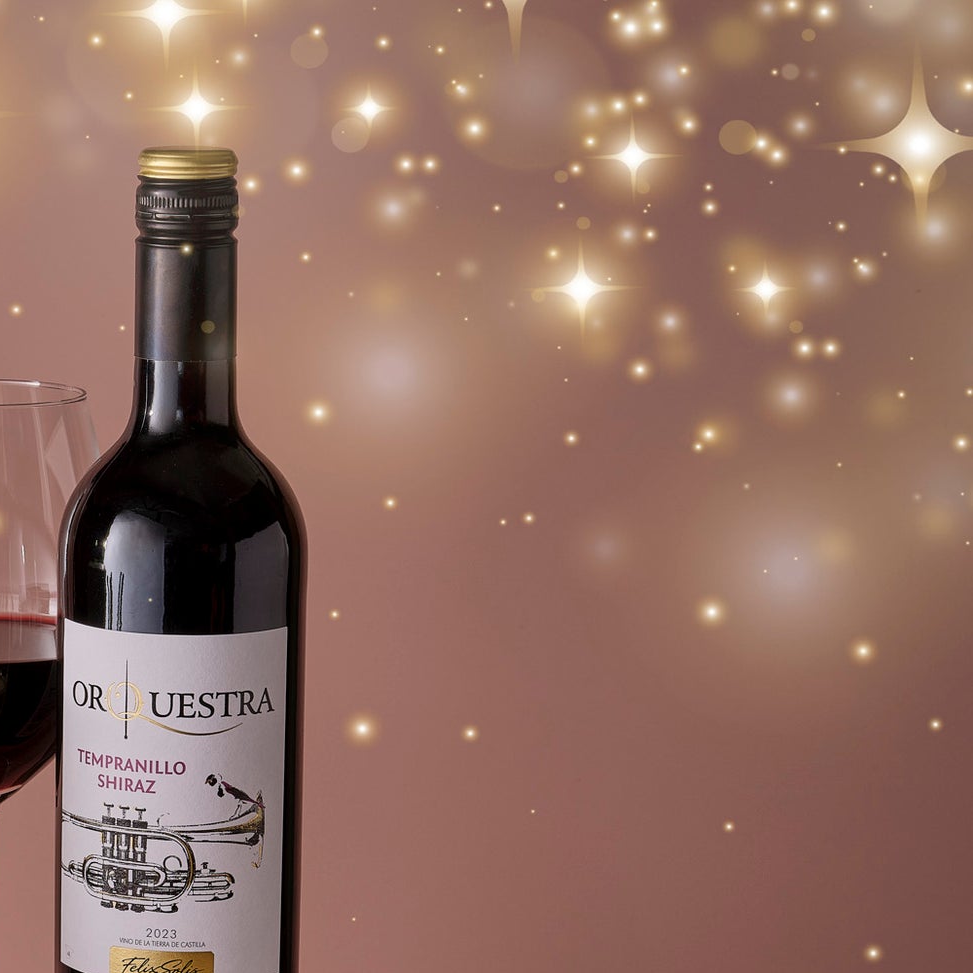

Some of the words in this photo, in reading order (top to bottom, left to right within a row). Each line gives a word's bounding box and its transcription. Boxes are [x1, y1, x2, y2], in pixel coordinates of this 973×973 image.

[72, 680, 275, 736] ORQUESTRA
[77, 748, 187, 775] TEMPRANILLO
[97, 774, 157, 795] SHIRAZ
[119, 937, 134, 945] VINO
[152, 940, 170, 948] TIERRA
[145, 928, 178, 940] 2023
